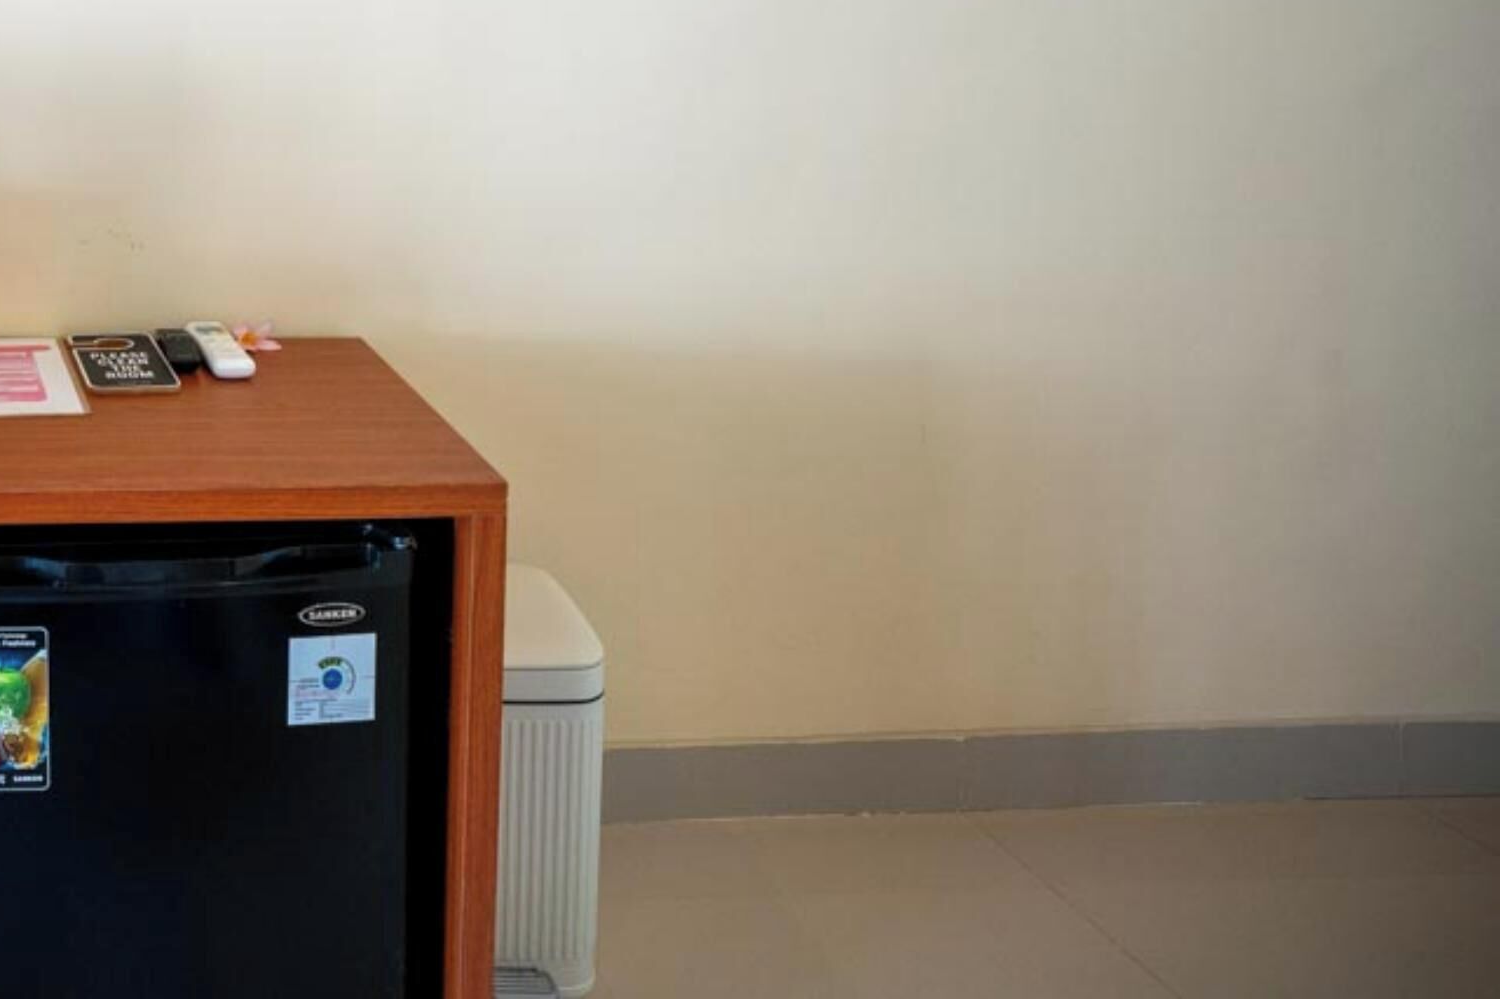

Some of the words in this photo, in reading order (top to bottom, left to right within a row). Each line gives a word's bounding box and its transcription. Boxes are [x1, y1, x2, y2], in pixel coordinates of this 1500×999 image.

[89, 351, 149, 360] PLEASE
[97, 358, 149, 367] CLEAN
[112, 364, 142, 373] THE
[105, 370, 155, 379] ROOM
[308, 609, 357, 620] SANKEN
